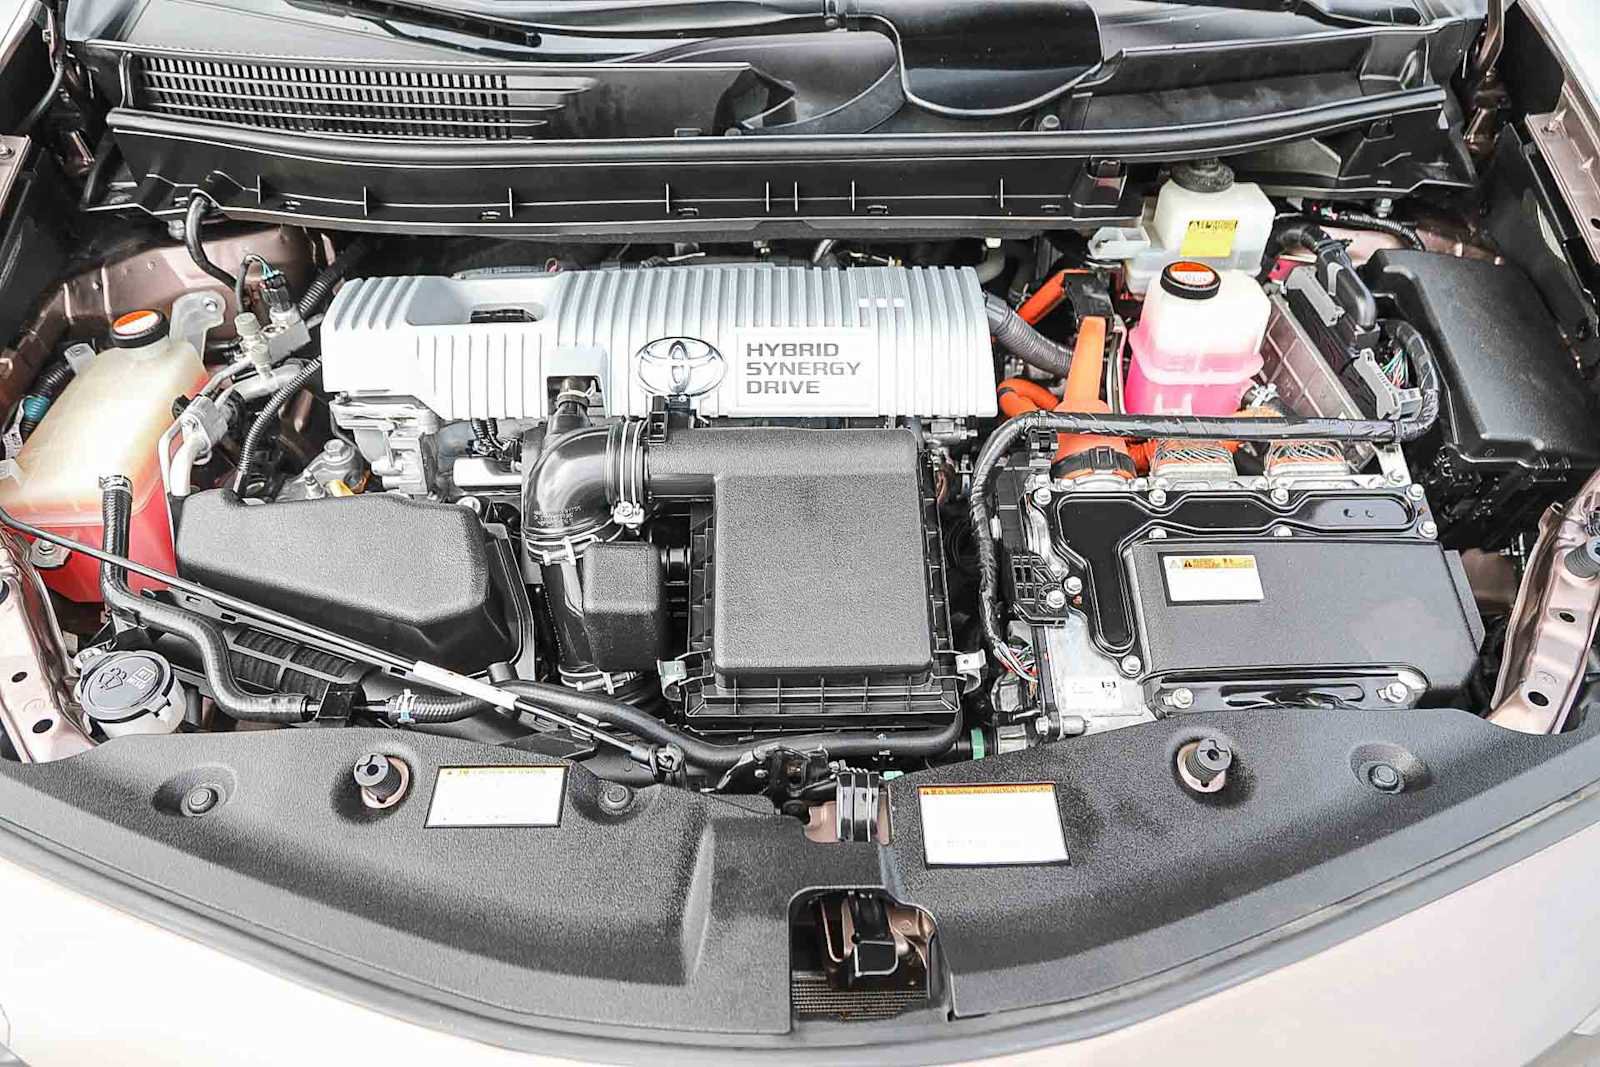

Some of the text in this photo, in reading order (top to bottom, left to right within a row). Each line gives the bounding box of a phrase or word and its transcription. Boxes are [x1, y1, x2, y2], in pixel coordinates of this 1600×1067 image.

[746, 343, 839, 357] HYBRID
[746, 361, 861, 376] SYNERGY
[746, 380, 820, 394] DRIVE
